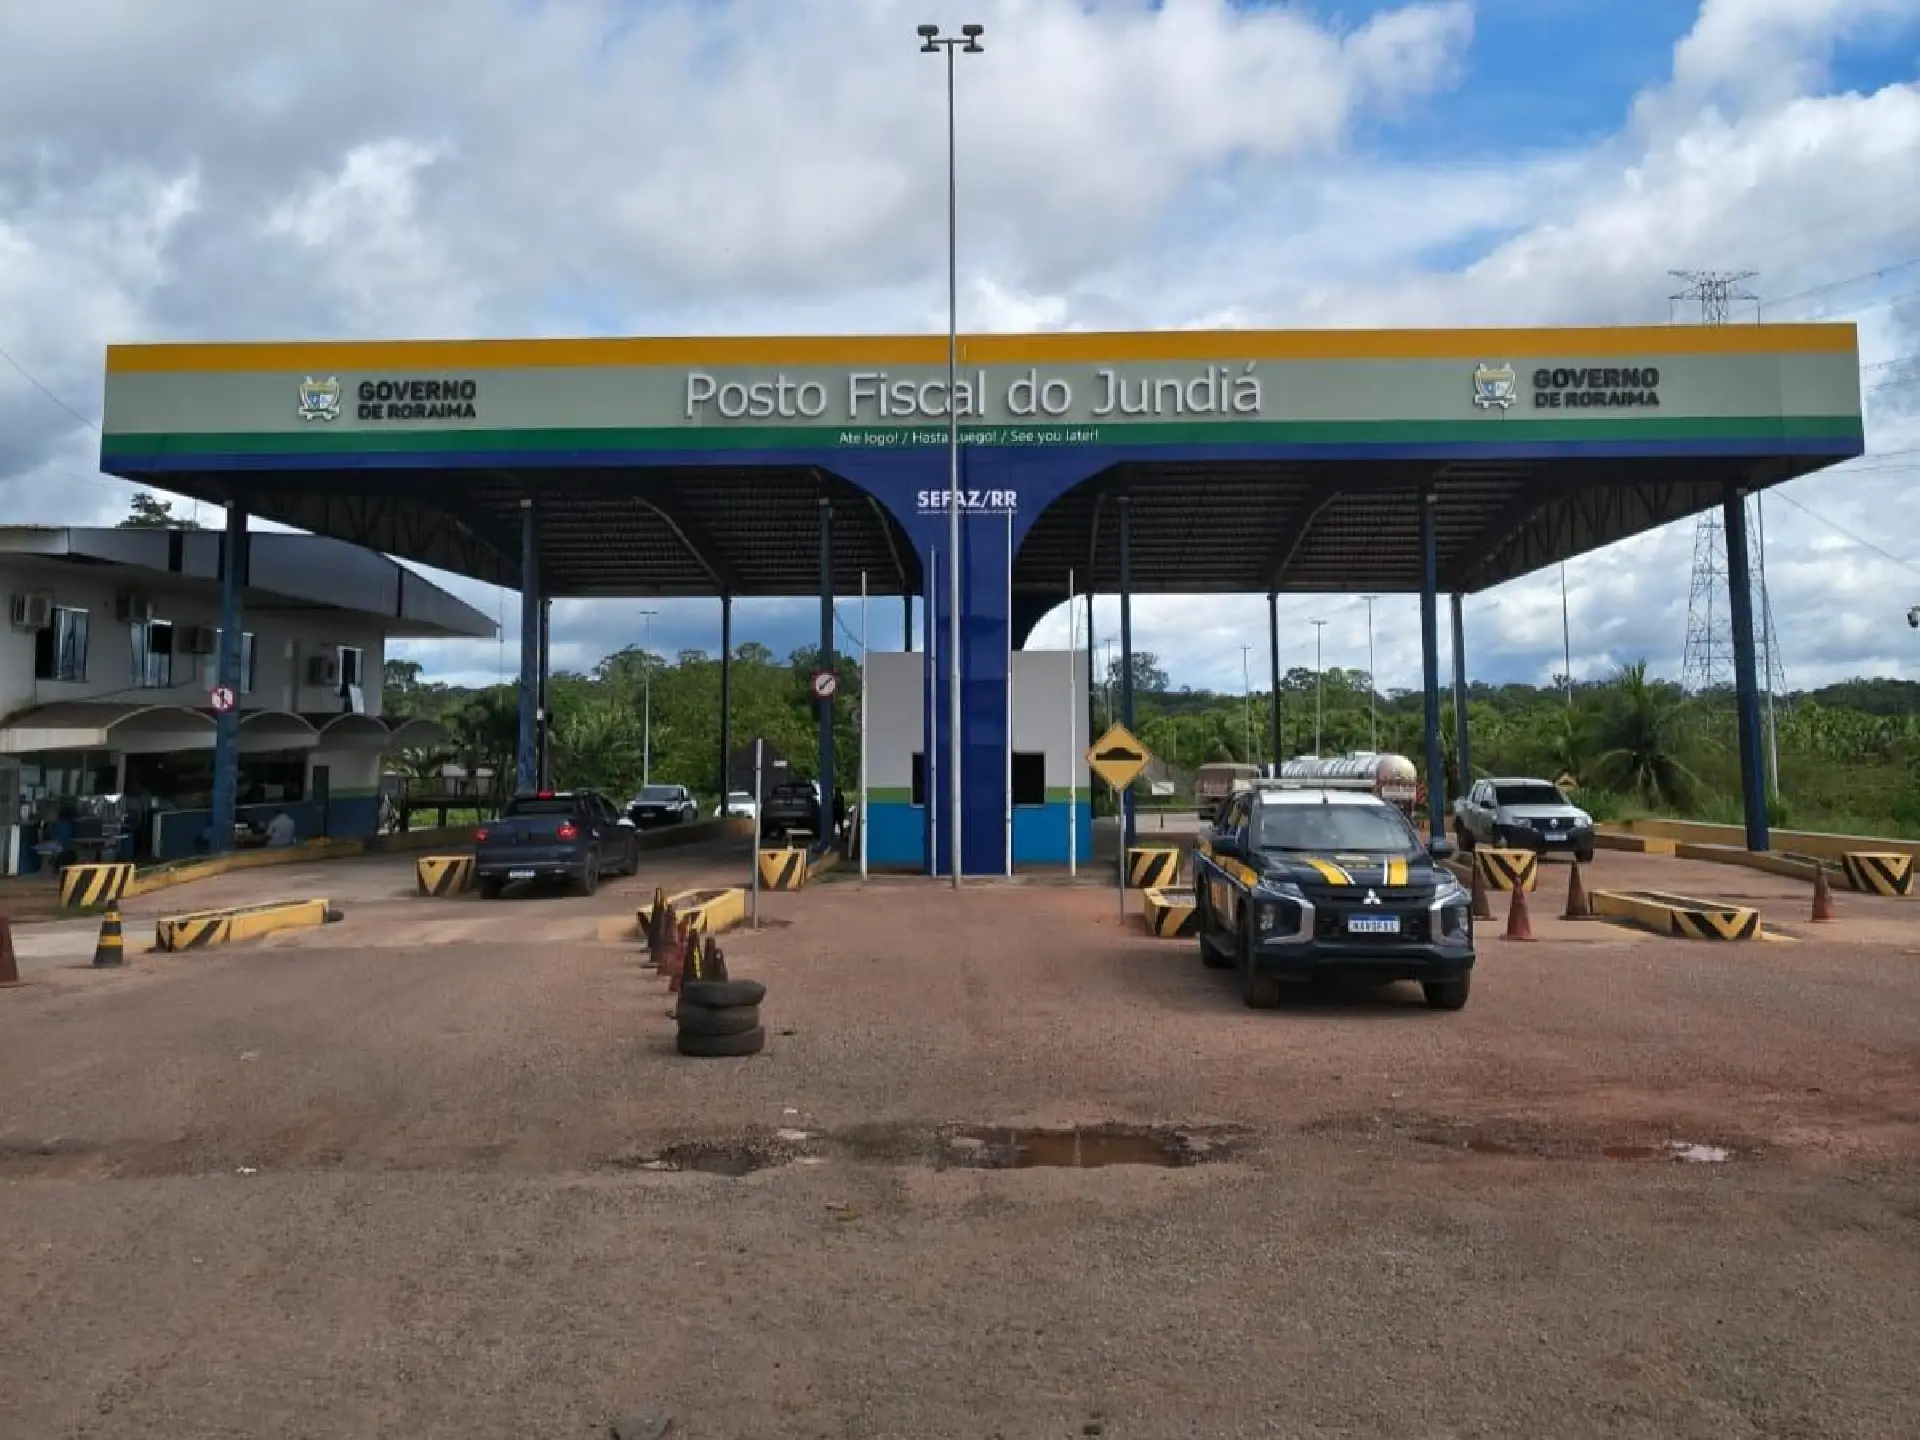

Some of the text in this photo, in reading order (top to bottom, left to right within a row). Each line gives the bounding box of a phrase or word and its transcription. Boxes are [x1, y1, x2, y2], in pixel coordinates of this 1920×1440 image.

[1534, 368, 1660, 388] GOVERNO
[358, 380, 476, 400] GOVERNO
[684, 360, 1262, 417] Posto Fiscal do Jundiá
[1535, 391, 1660, 407] DE RORAIMA
[358, 403, 476, 419] DE RORAIMA
[864, 431, 898, 446] logo!
[912, 432, 949, 444] Hasta
[1011, 429, 1034, 442] See
[1038, 431, 1061, 444] you
[1066, 427, 1099, 442] later!
[917, 490, 1017, 508] SEFAZ/RR
